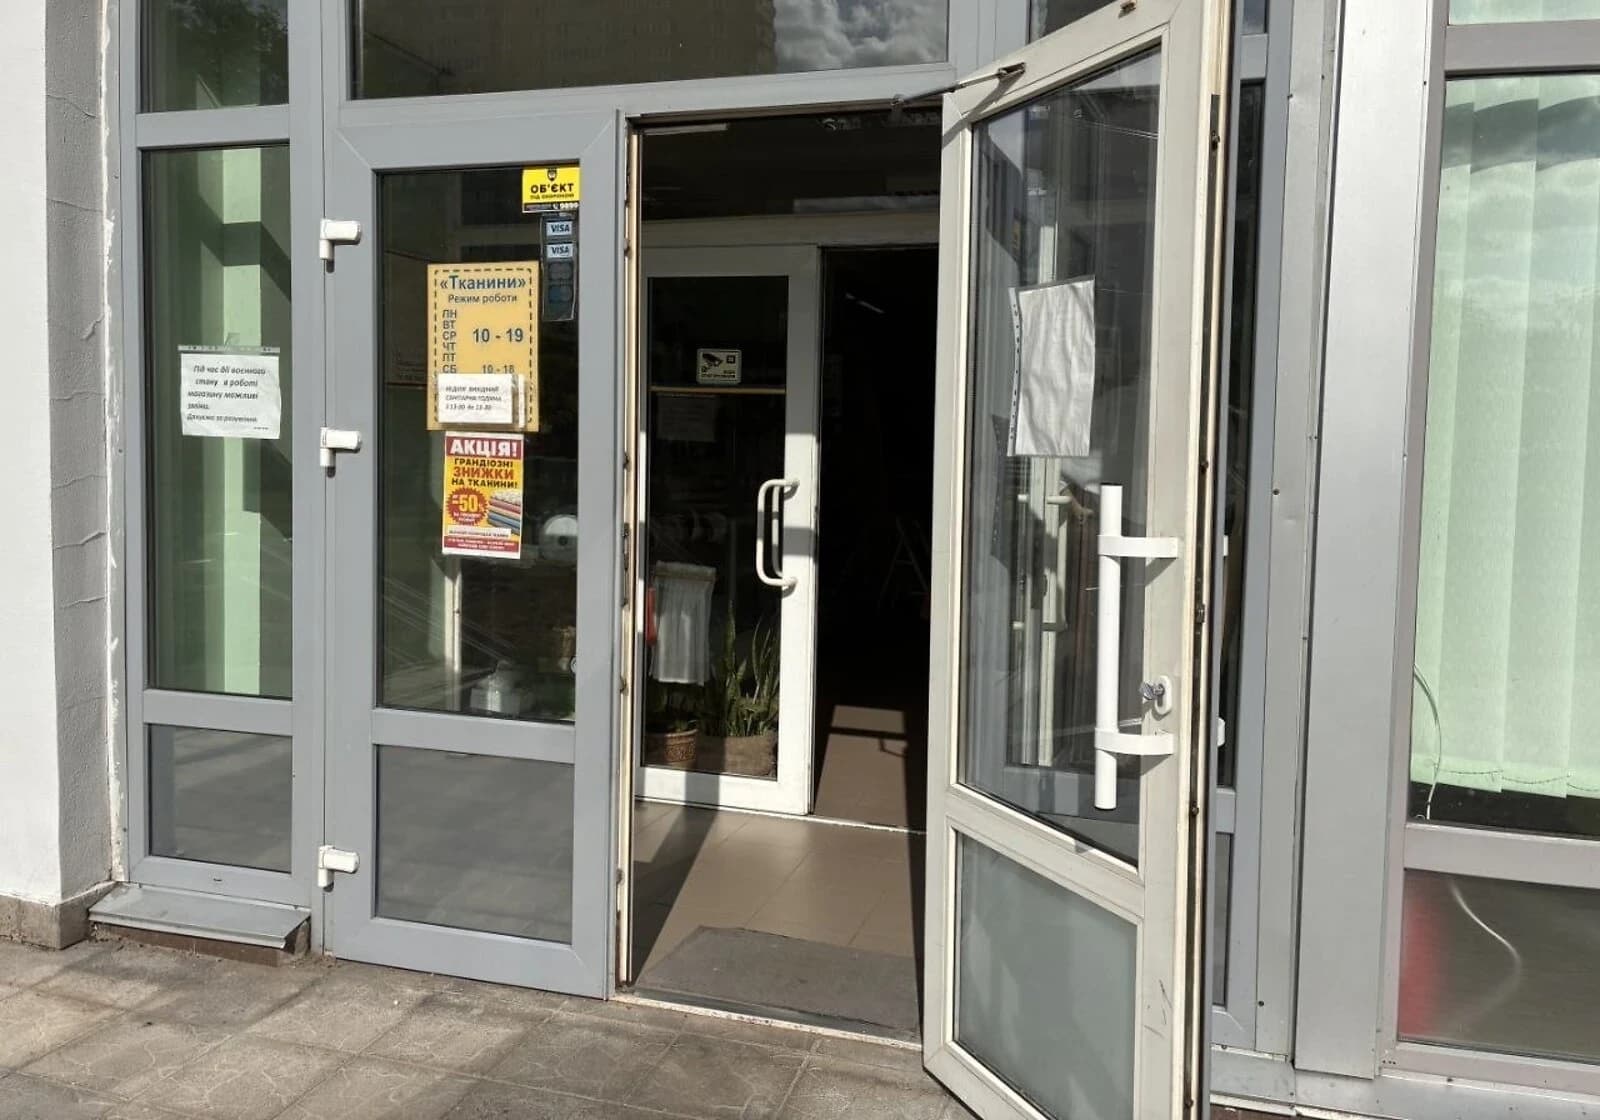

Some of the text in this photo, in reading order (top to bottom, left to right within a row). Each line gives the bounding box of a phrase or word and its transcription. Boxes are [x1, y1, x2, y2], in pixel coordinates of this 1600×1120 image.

[530, 183, 574, 193] ОБ'ЄКТ
[551, 224, 570, 232] VISA
[551, 246, 569, 254] VISA
[440, 275, 527, 290] «Тканини»
[448, 293, 518, 304] Режим роботи
[442, 309, 457, 319] ПН
[443, 320, 456, 330] ВТ
[442, 331, 457, 341] СР
[473, 328, 490, 343] 10
[506, 327, 524, 343] 19
[442, 342, 456, 351] ЧТ
[442, 353, 456, 362] ПТ
[442, 364, 457, 374] СБ
[482, 364, 494, 374] 10
[195, 379, 218, 387] стану
[229, 379, 258, 387] роботі
[449, 439, 518, 458] АКЦІЯ!
[454, 458, 513, 468] ГРАНДІОЗНІ
[453, 467, 514, 480] ЗНИЖКИ
[451, 478, 518, 489] НА ТКАНИНИ!
